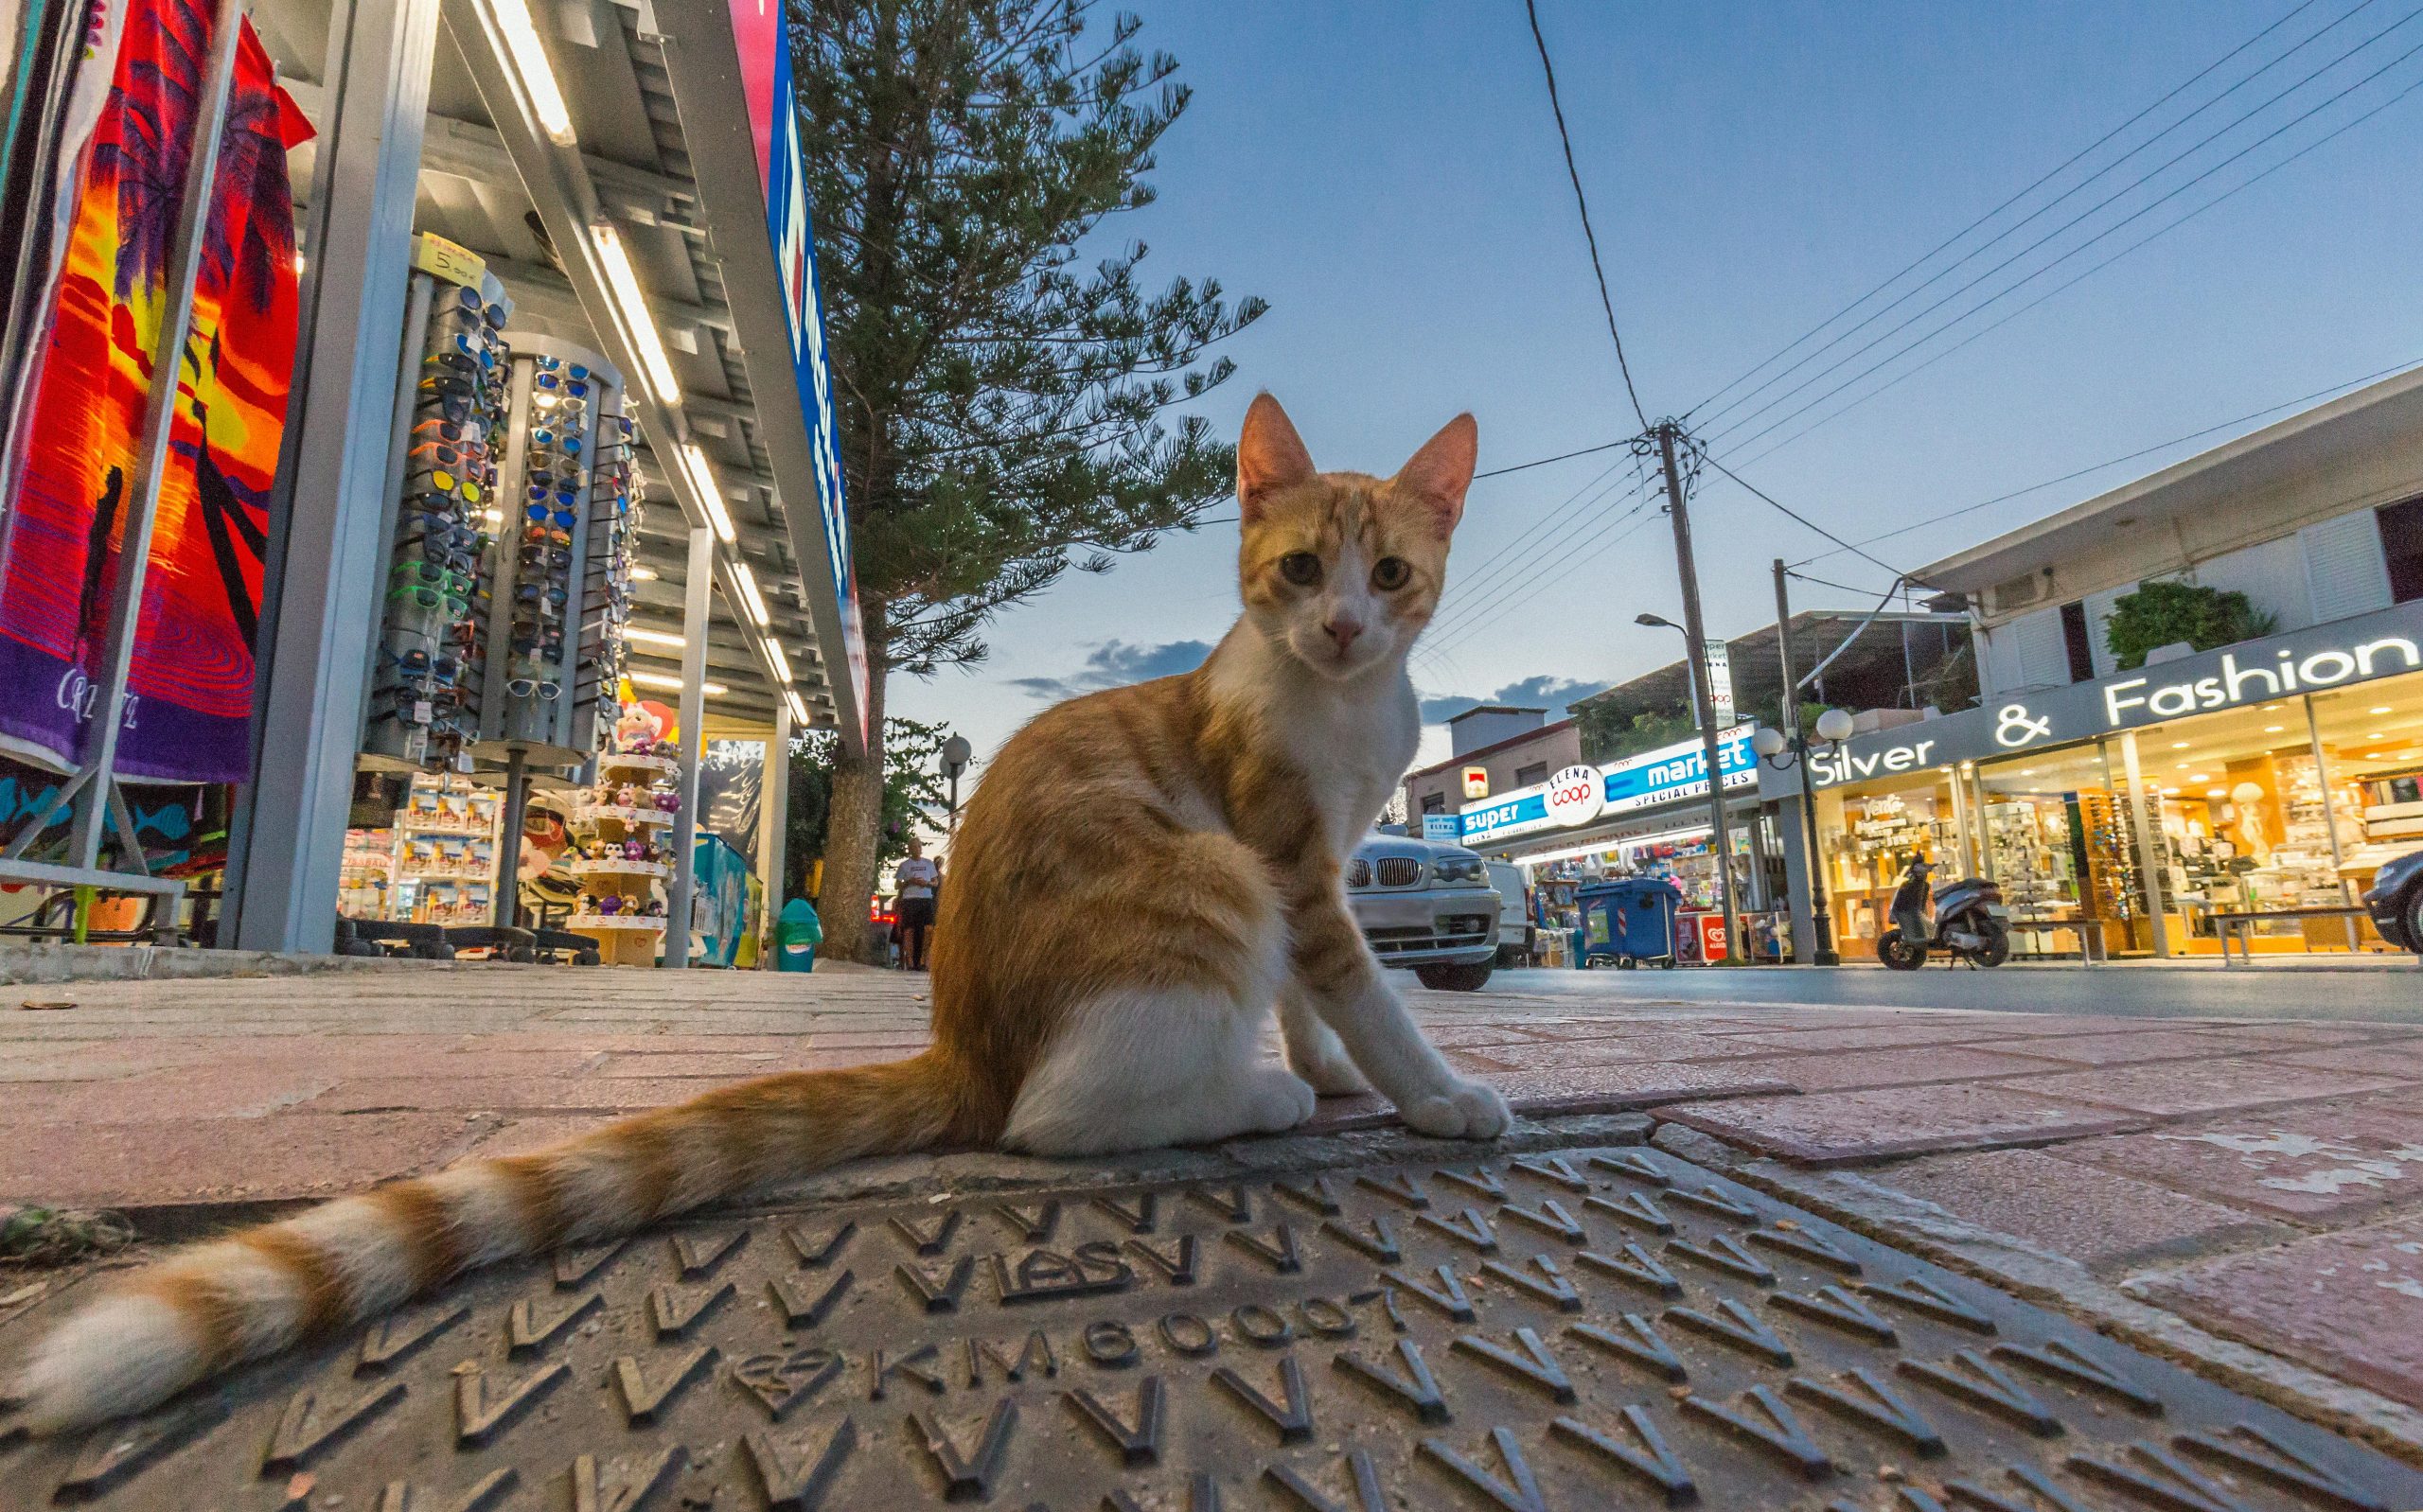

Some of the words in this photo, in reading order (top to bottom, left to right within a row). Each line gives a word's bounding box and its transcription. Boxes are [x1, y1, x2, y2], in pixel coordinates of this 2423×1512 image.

[1809, 740, 1935, 786] Silver
[1995, 704, 2052, 747] &
[2104, 638, 2420, 727] Fashion
[1549, 767, 1590, 789] ELENA
[1635, 787, 1689, 807] SPECIAL
[1694, 772, 1749, 794] PRCES
[1553, 783, 1590, 806] coop
